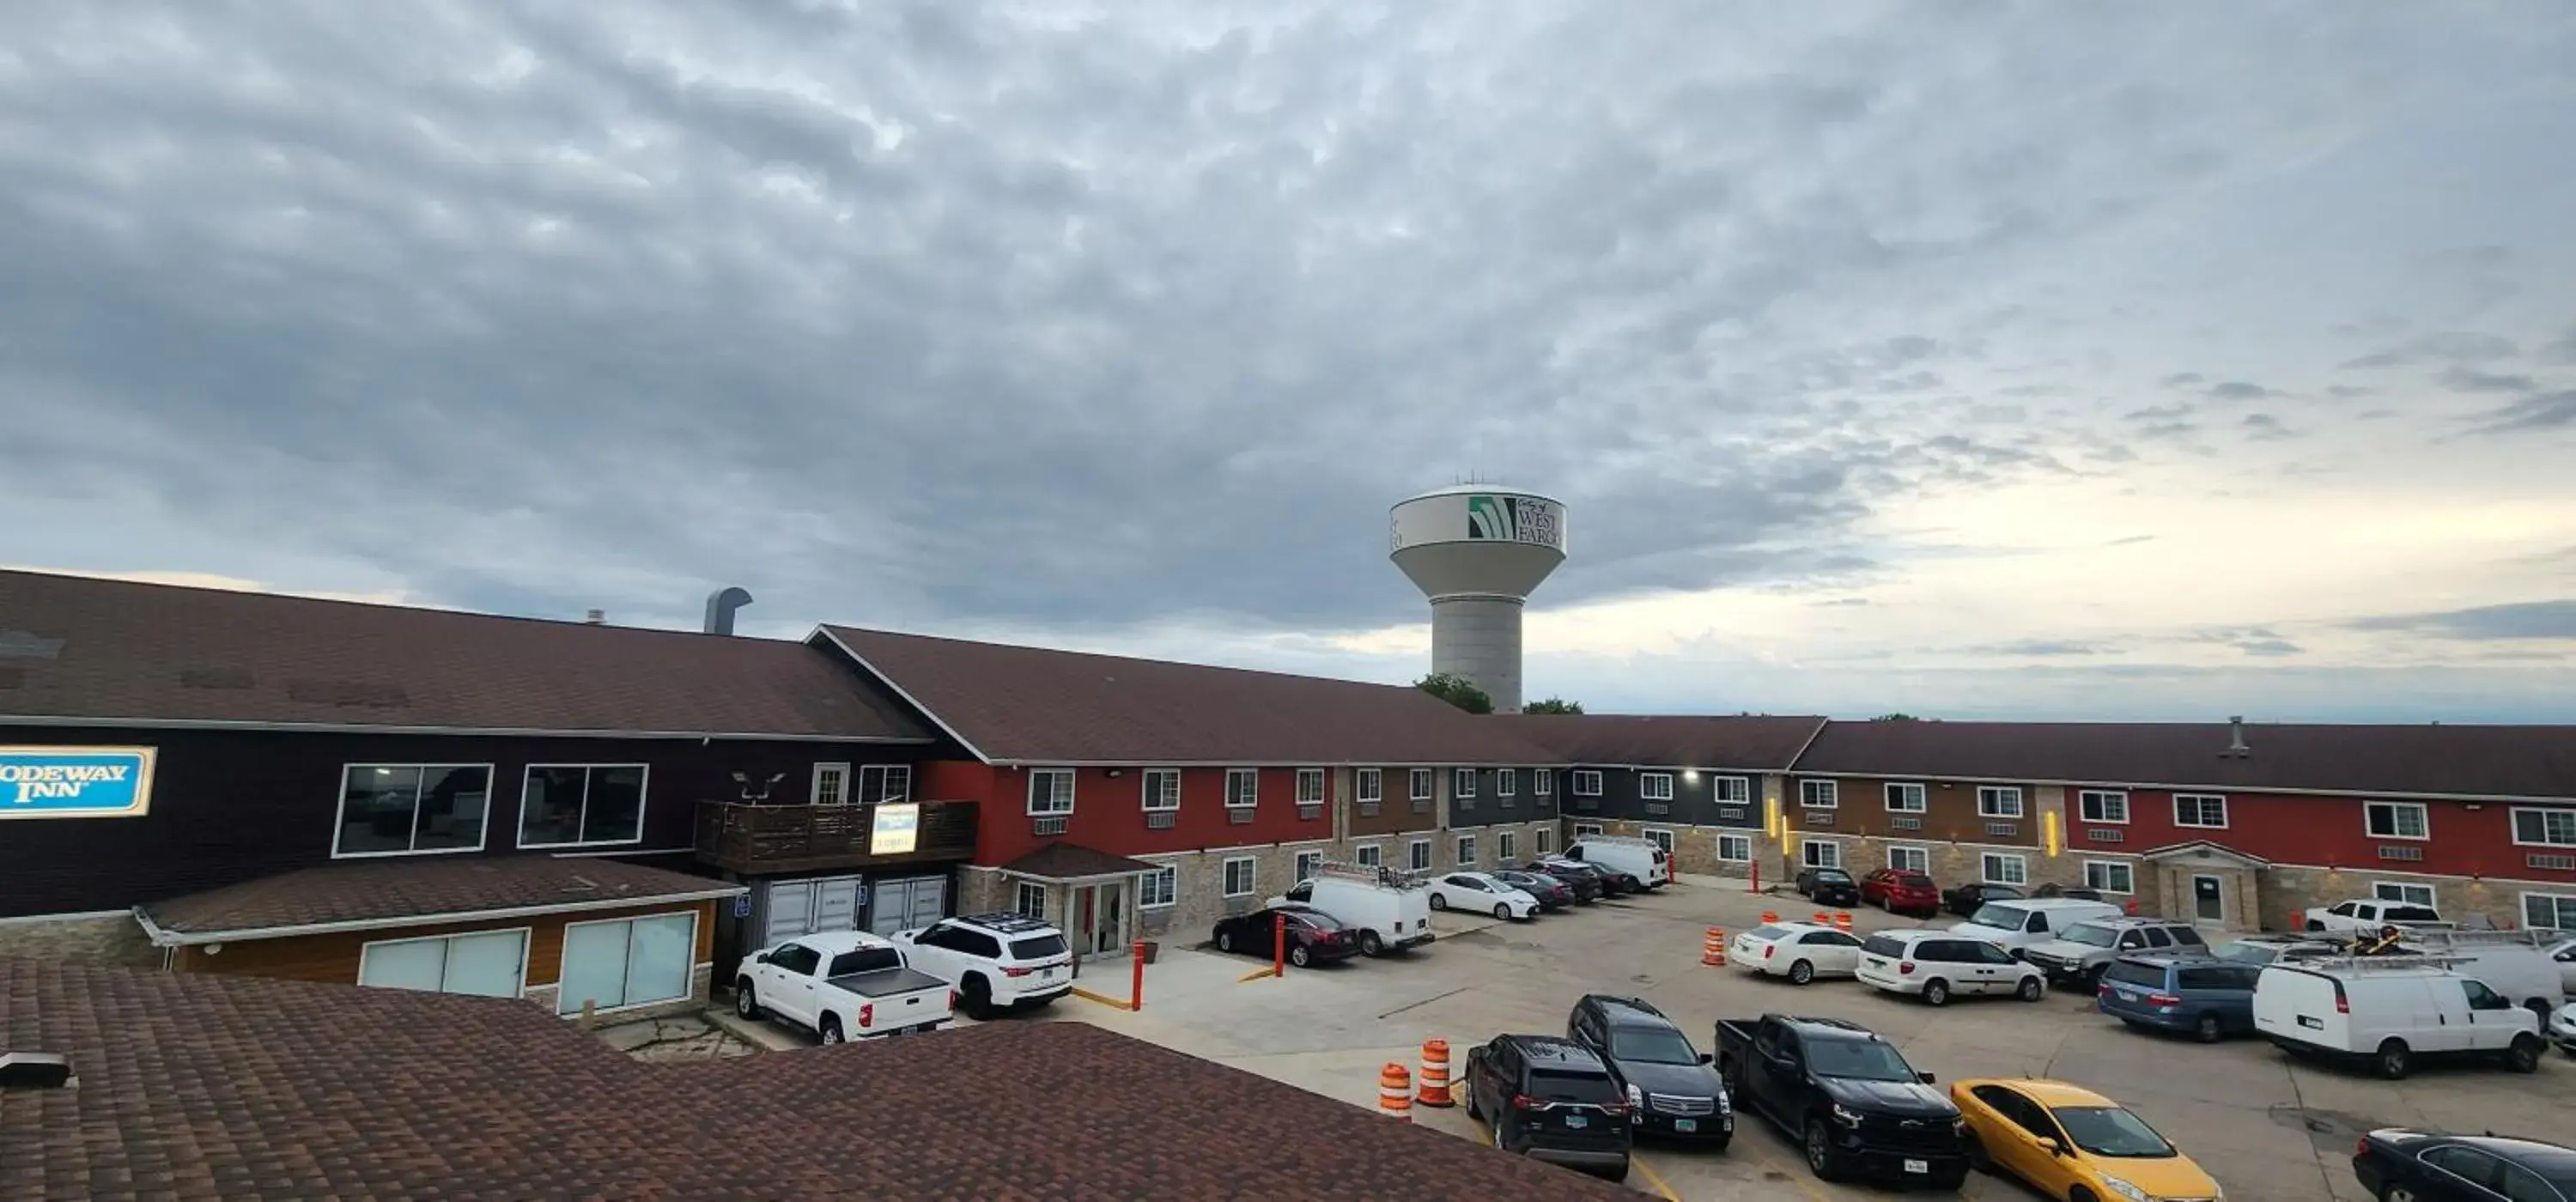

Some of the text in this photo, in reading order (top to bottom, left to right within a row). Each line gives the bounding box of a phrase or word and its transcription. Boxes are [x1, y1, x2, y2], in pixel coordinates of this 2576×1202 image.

[1518, 509, 1555, 530] WEST
[0, 764, 130, 782] ODEWAY
[14, 781, 81, 803] INN
